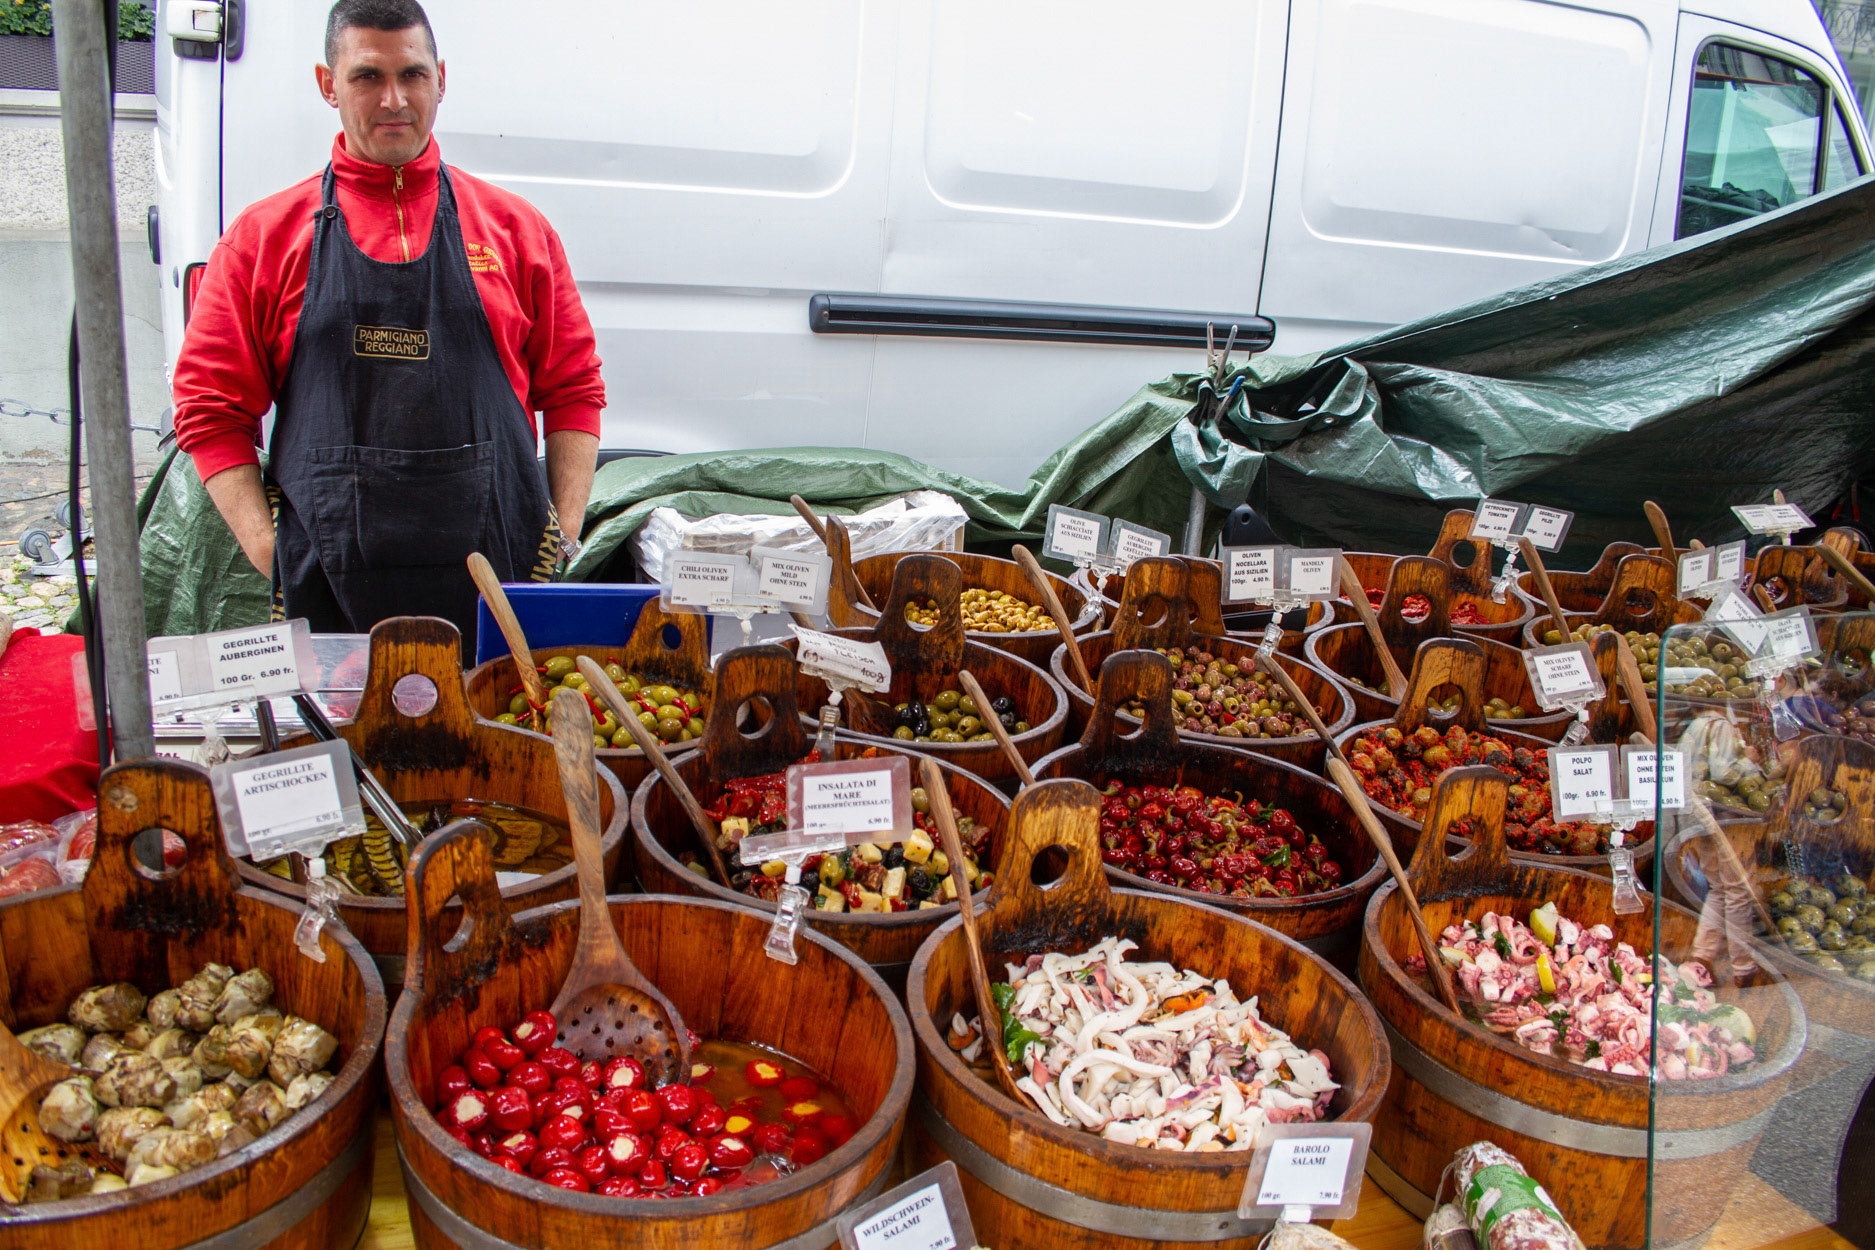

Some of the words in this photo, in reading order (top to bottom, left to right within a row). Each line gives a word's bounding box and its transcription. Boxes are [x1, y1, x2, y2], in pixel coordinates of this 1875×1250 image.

[360, 329, 424, 344] PARMIGIANO
[365, 341, 418, 355] REGGIANO
[1060, 523, 1093, 534] SCHIACCIATE
[1071, 532, 1092, 541] SIZILIEN
[1128, 535, 1153, 546] GEGRILLTE
[1126, 541, 1152, 552] AUBERGINE
[786, 564, 809, 573] OLIVEN
[769, 577, 788, 586] OHNE
[223, 634, 278, 650] GEGRILLTE
[219, 645, 285, 662] AUBERGINEN
[221, 676, 238, 685] 100
[260, 668, 281, 678] 6.90
[252, 762, 314, 782] GEGRILLTE
[243, 771, 328, 796] ARTISCHOCKEN
[818, 781, 864, 791] INSALATA
[833, 792, 861, 800] MARE
[805, 799, 891, 810] (MEERESFRÜCHTESALAT)
[1293, 1145, 1330, 1154] BAROLO
[1291, 1157, 1326, 1165] SALAMI
[862, 1195, 935, 1237] WILDSCHWEIN-
[883, 1215, 920, 1240] SALAMI
